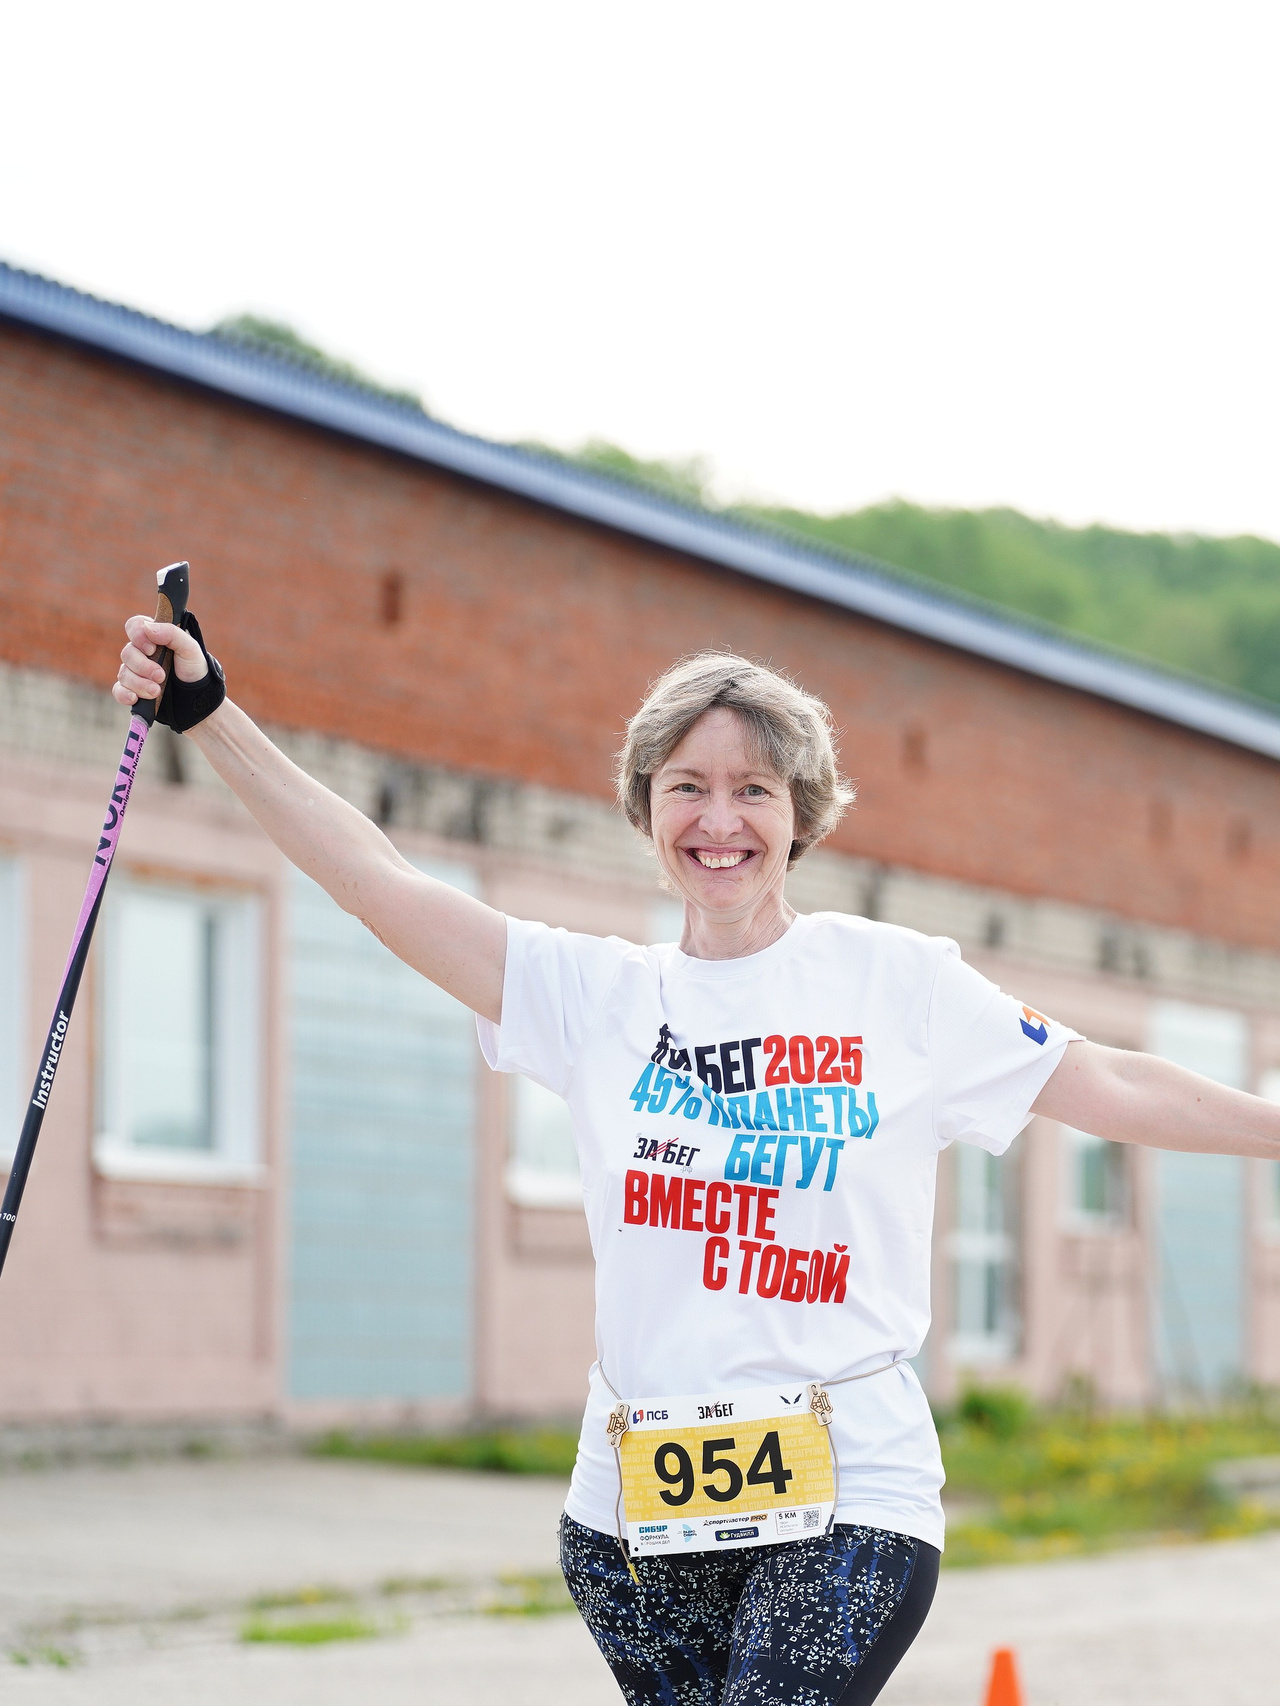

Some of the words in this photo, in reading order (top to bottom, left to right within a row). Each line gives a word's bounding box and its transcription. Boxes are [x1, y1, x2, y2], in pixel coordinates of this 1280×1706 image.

[132, 736, 145, 770] Norway
[32, 1010, 69, 1110] Instructor
[629, 1062, 703, 1120] 45%
[702, 1084, 879, 1139] ПЛАНЕТЫ
[724, 1134, 845, 1191] БЕГУТ
[624, 1169, 779, 1241] ВМЕСТЕ
[703, 1236, 730, 1291] С
[738, 1240, 850, 1304] ТОБОЙ
[646, 1410, 669, 1421] ПСБ
[654, 1431, 793, 1506] 954
[639, 1525, 668, 1533] СИБУР
